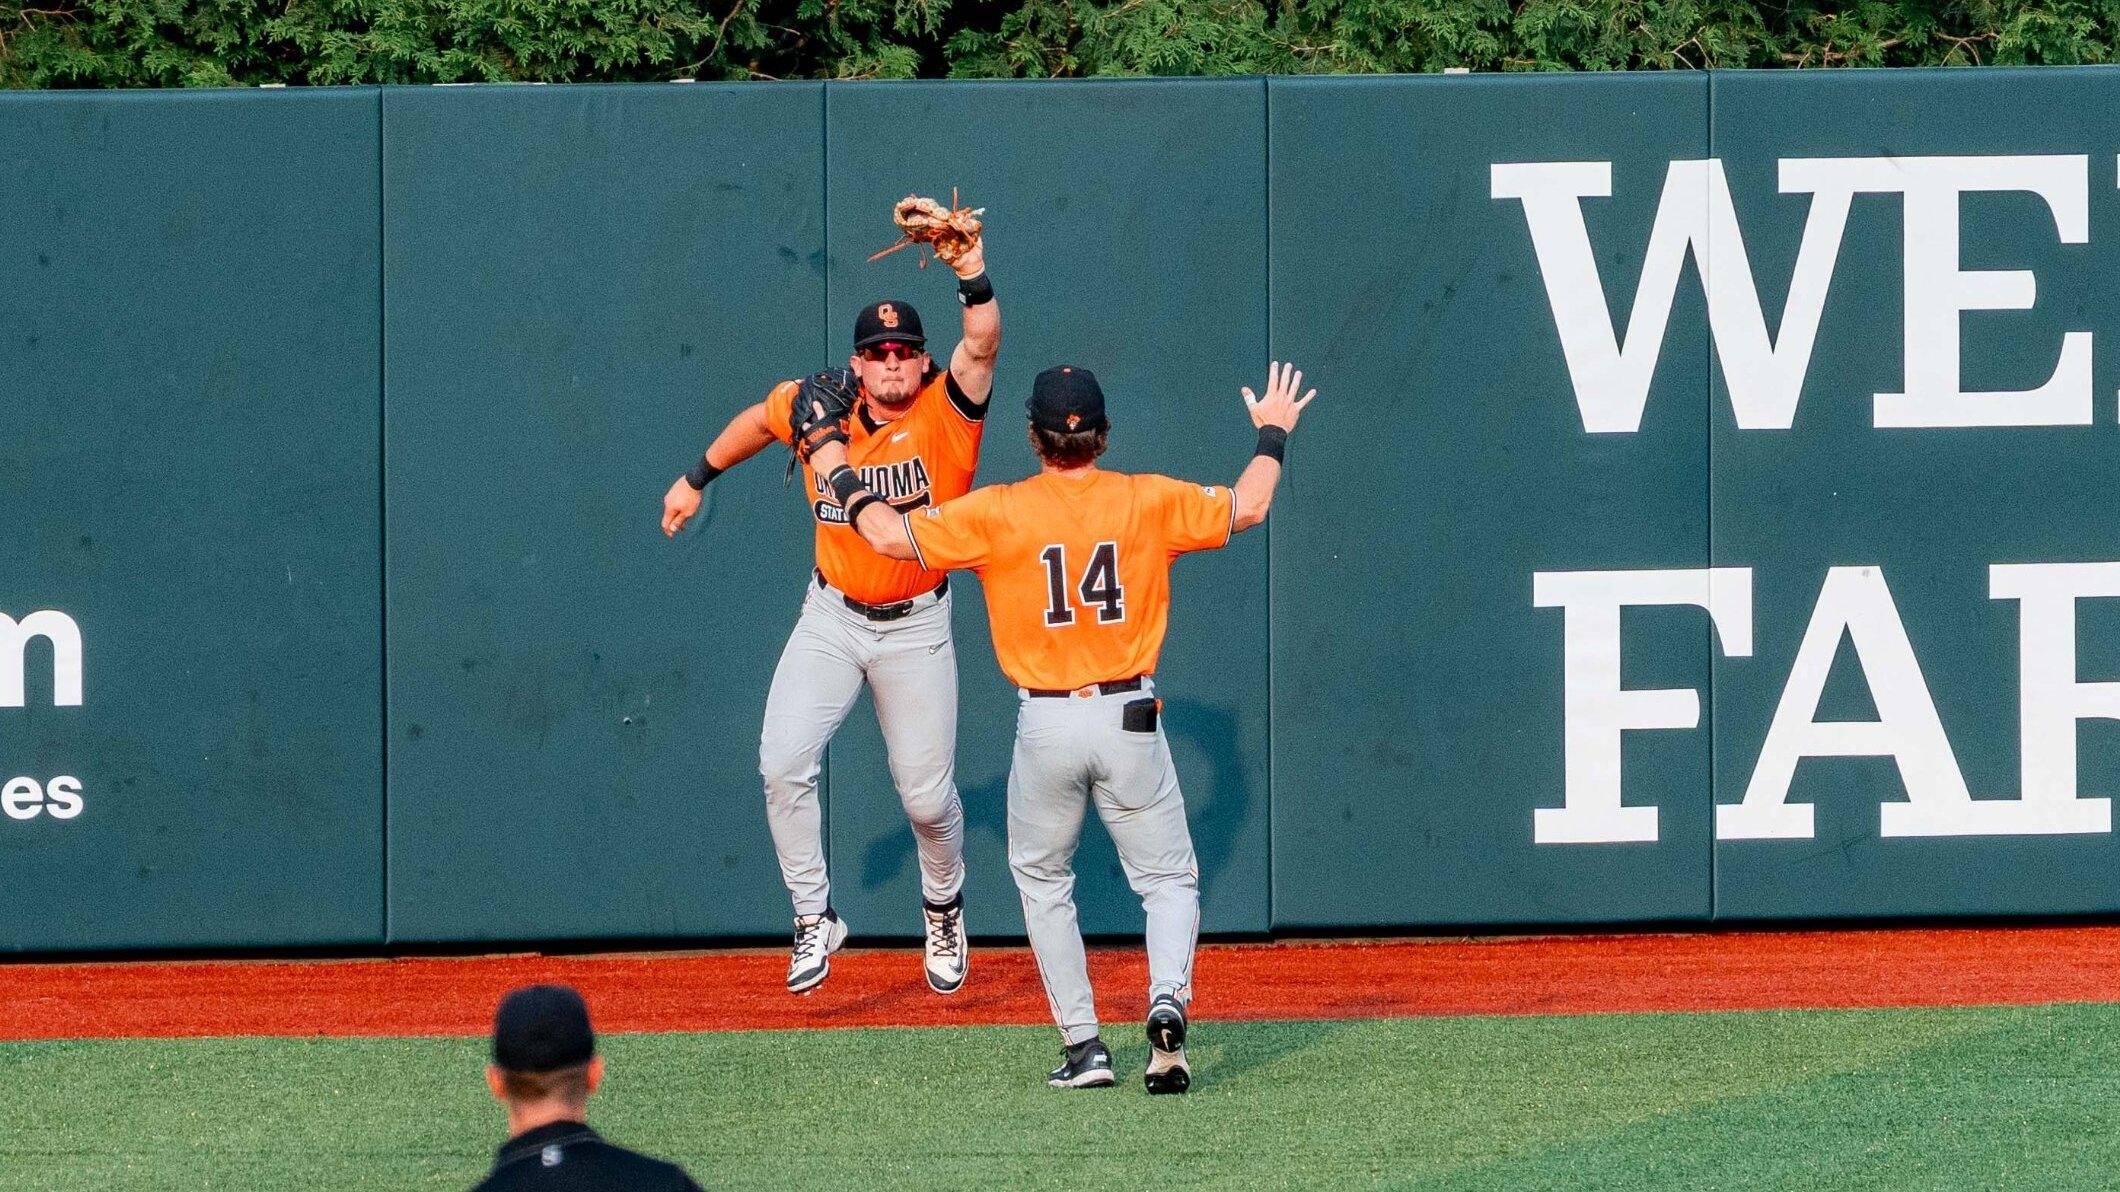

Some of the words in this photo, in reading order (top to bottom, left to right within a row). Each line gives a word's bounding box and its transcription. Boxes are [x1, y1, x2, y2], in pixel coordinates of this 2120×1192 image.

[1490, 154, 2120, 433] WE
[815, 456, 930, 500] OHOMA
[1040, 541, 1125, 627] 14
[1, 775, 84, 819] es
